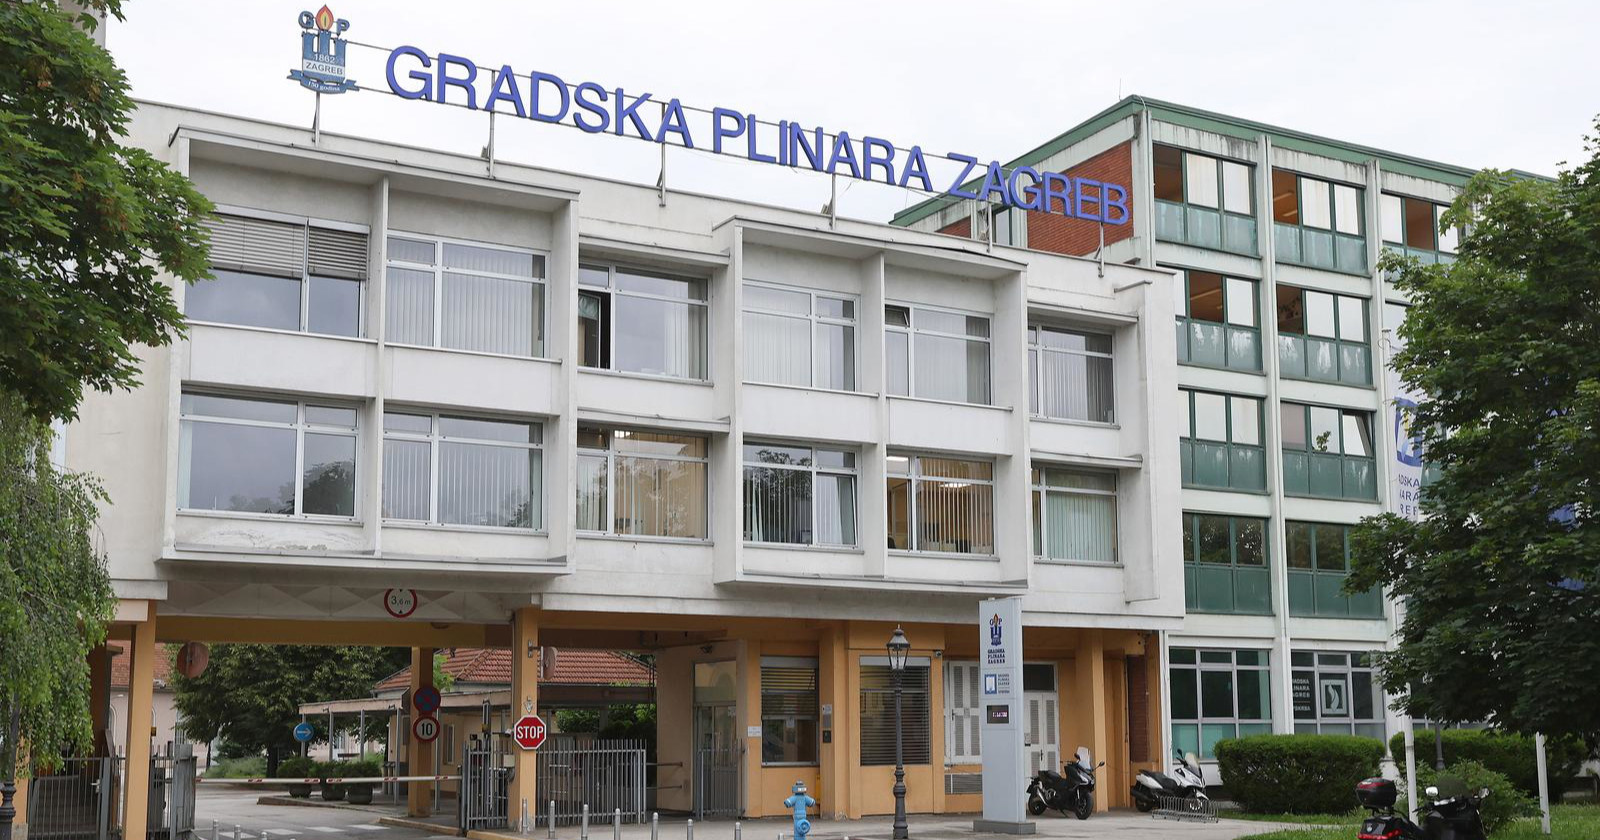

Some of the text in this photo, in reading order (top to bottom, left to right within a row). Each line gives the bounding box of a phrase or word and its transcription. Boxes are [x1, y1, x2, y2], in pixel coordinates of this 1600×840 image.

[337, 19, 350, 36] P
[305, 61, 343, 76] ZAGREB
[386, 45, 1129, 226] GRADSKA PLINARA ZAGREB
[421, 722, 433, 736] 10
[516, 725, 544, 739] STOP
